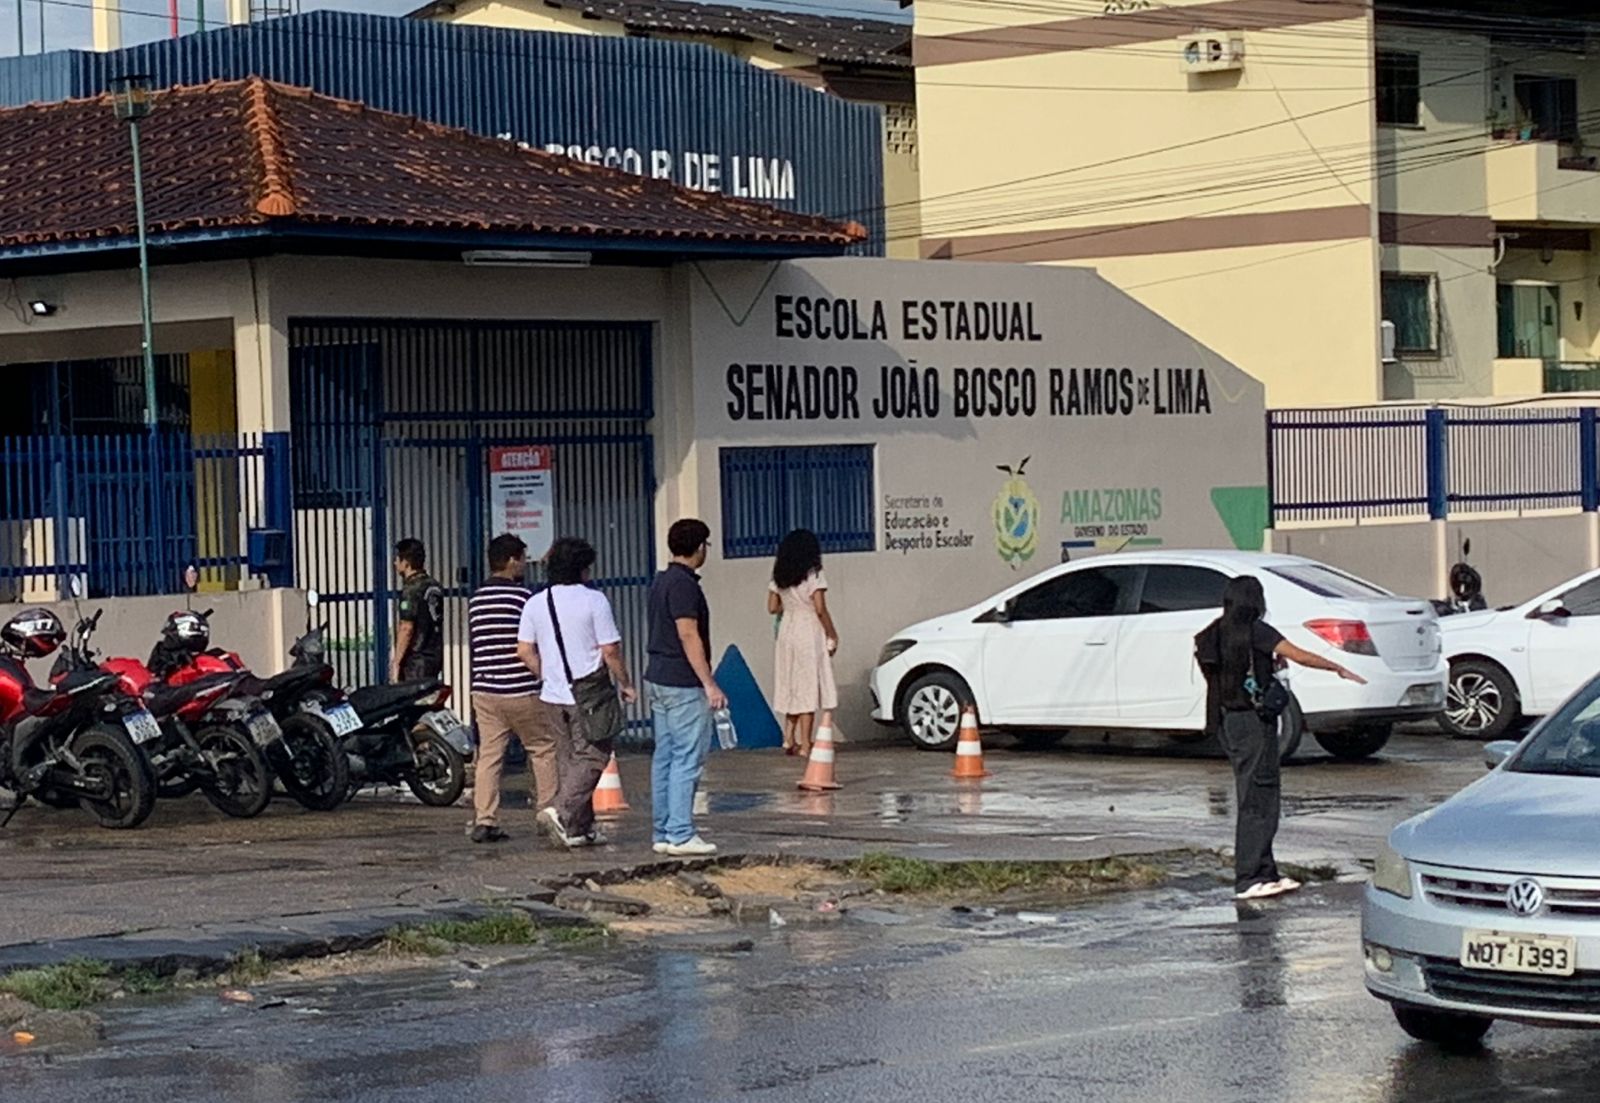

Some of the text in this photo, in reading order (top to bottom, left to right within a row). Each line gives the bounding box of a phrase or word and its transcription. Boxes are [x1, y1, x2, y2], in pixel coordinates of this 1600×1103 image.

[684, 151, 721, 193] DE
[732, 155, 796, 200] LIMA
[774, 295, 1043, 342] ESCOLA ESTADUAL
[726, 362, 860, 421] SENADOR
[873, 358, 940, 419] JOÃO
[953, 367, 1037, 418] BOSCO
[1049, 367, 1134, 416] RAMOS
[1153, 367, 1212, 415] LIMA
[884, 510, 949, 530] Educação e
[1060, 487, 1163, 524] AMAZONAS
[885, 528, 974, 555] Desporto Escolar
[1074, 522, 1149, 538] GOVERNO DO ESTADO
